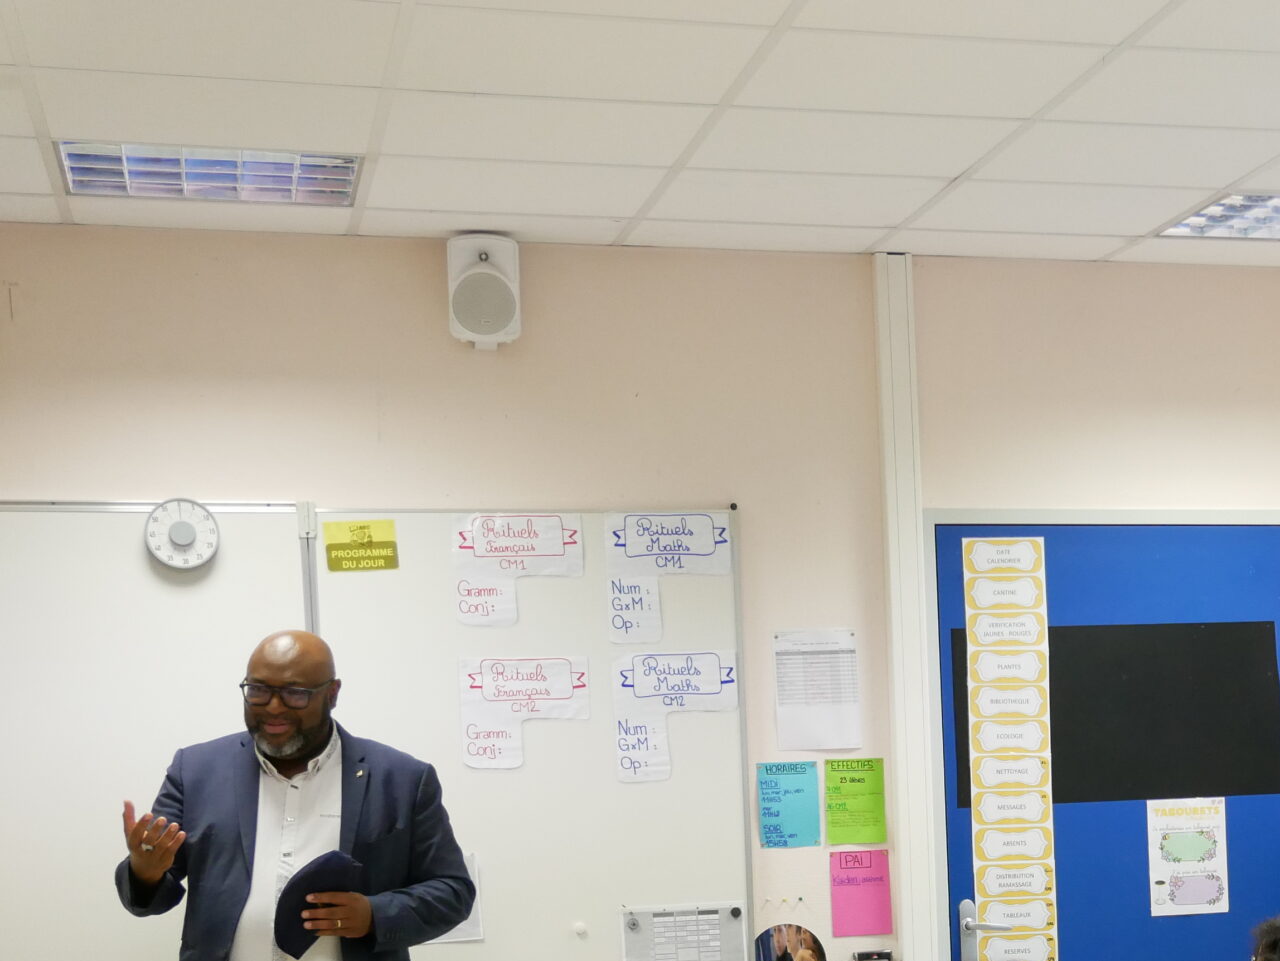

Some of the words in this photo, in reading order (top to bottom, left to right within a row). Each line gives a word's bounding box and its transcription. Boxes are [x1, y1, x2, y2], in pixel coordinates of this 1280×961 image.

[482, 518, 539, 539] Rituels
[636, 517, 694, 537] Rituels
[485, 540, 536, 554] Français
[646, 537, 691, 552] Maths
[331, 548, 395, 558] PROGRAMME
[342, 560, 356, 569] DU
[358, 559, 385, 568] JOUR
[500, 559, 527, 570] CM1
[655, 555, 685, 568] CM1
[491, 662, 548, 682] Rituels
[642, 656, 702, 677] Rituels
[653, 676, 701, 692] Maths
[494, 684, 551, 700] Français
[511, 701, 541, 712] CM2
[662, 695, 686, 706] CM2
[1153, 806, 1220, 817] TABOURETS
